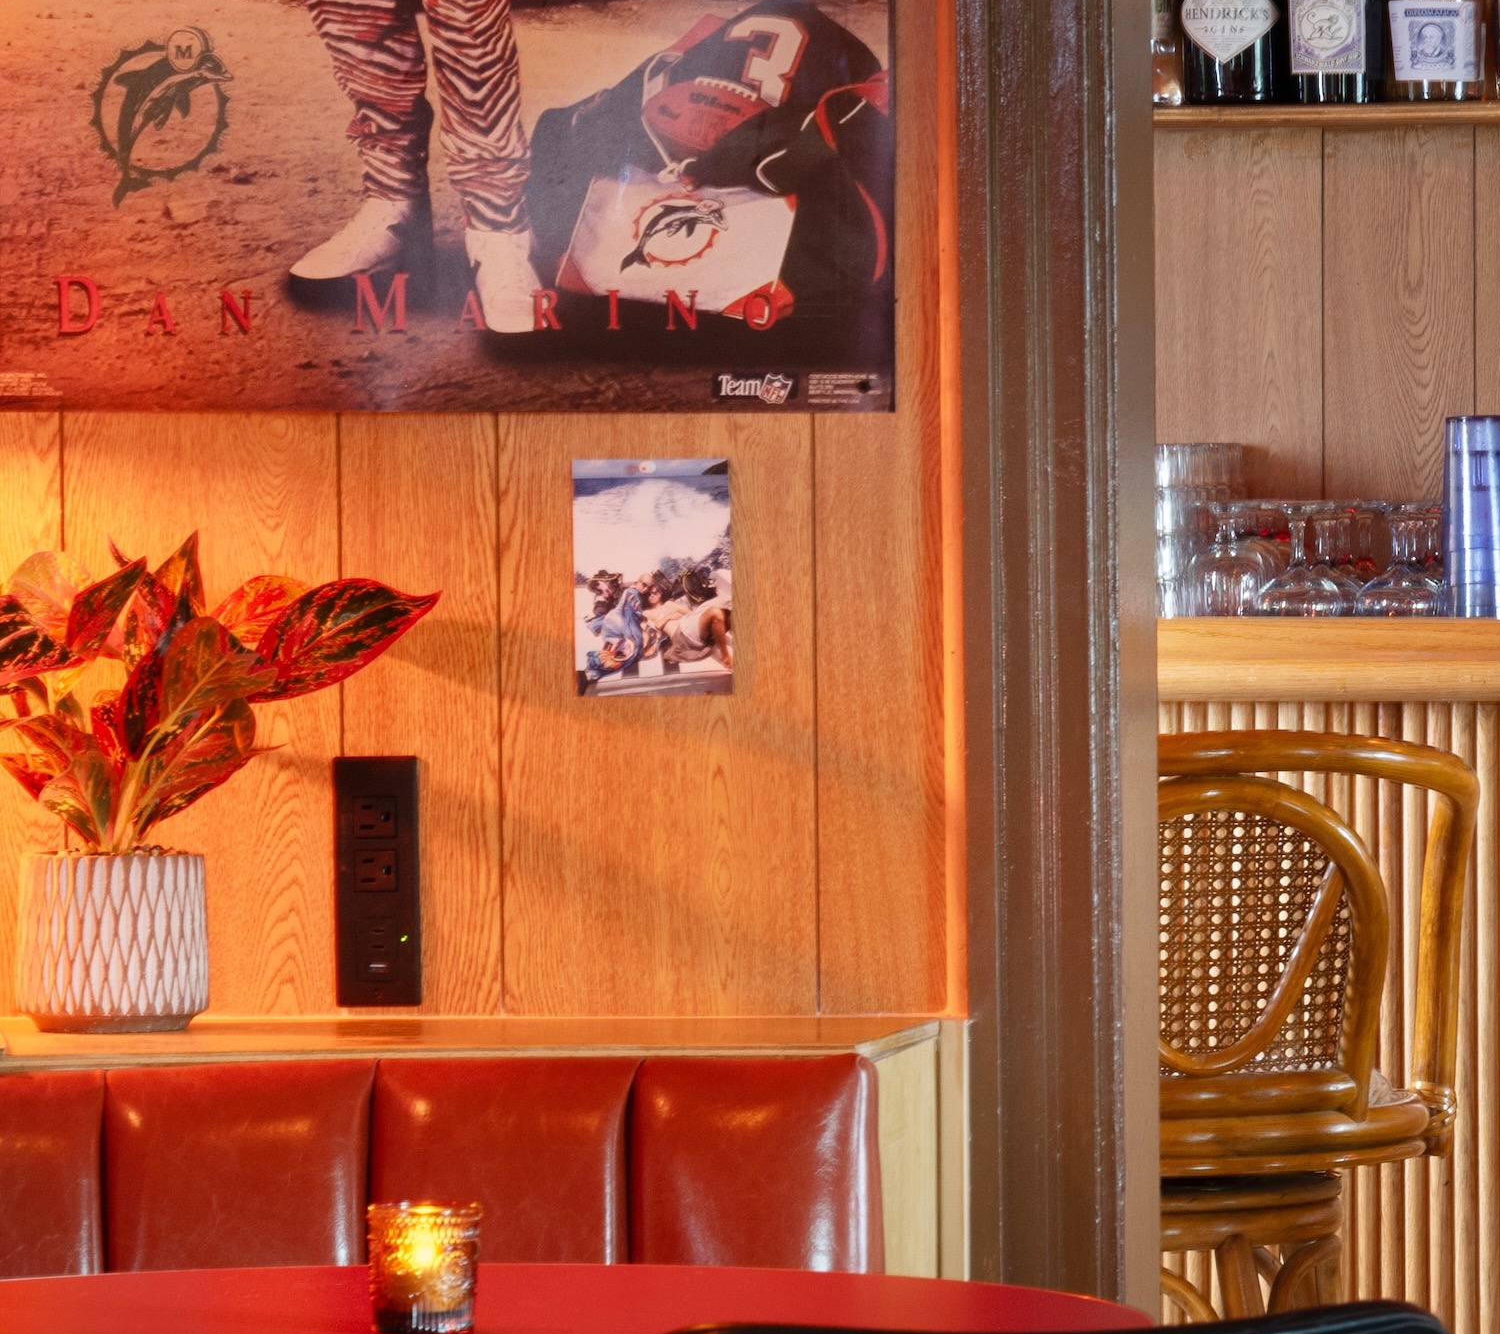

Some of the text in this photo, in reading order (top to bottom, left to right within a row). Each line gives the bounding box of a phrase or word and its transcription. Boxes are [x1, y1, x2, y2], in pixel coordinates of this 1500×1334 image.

[1185, 6, 1270, 22] HENDRICK'S
[1211, 26, 1239, 34] GIN
[717, 373, 762, 397] Team
